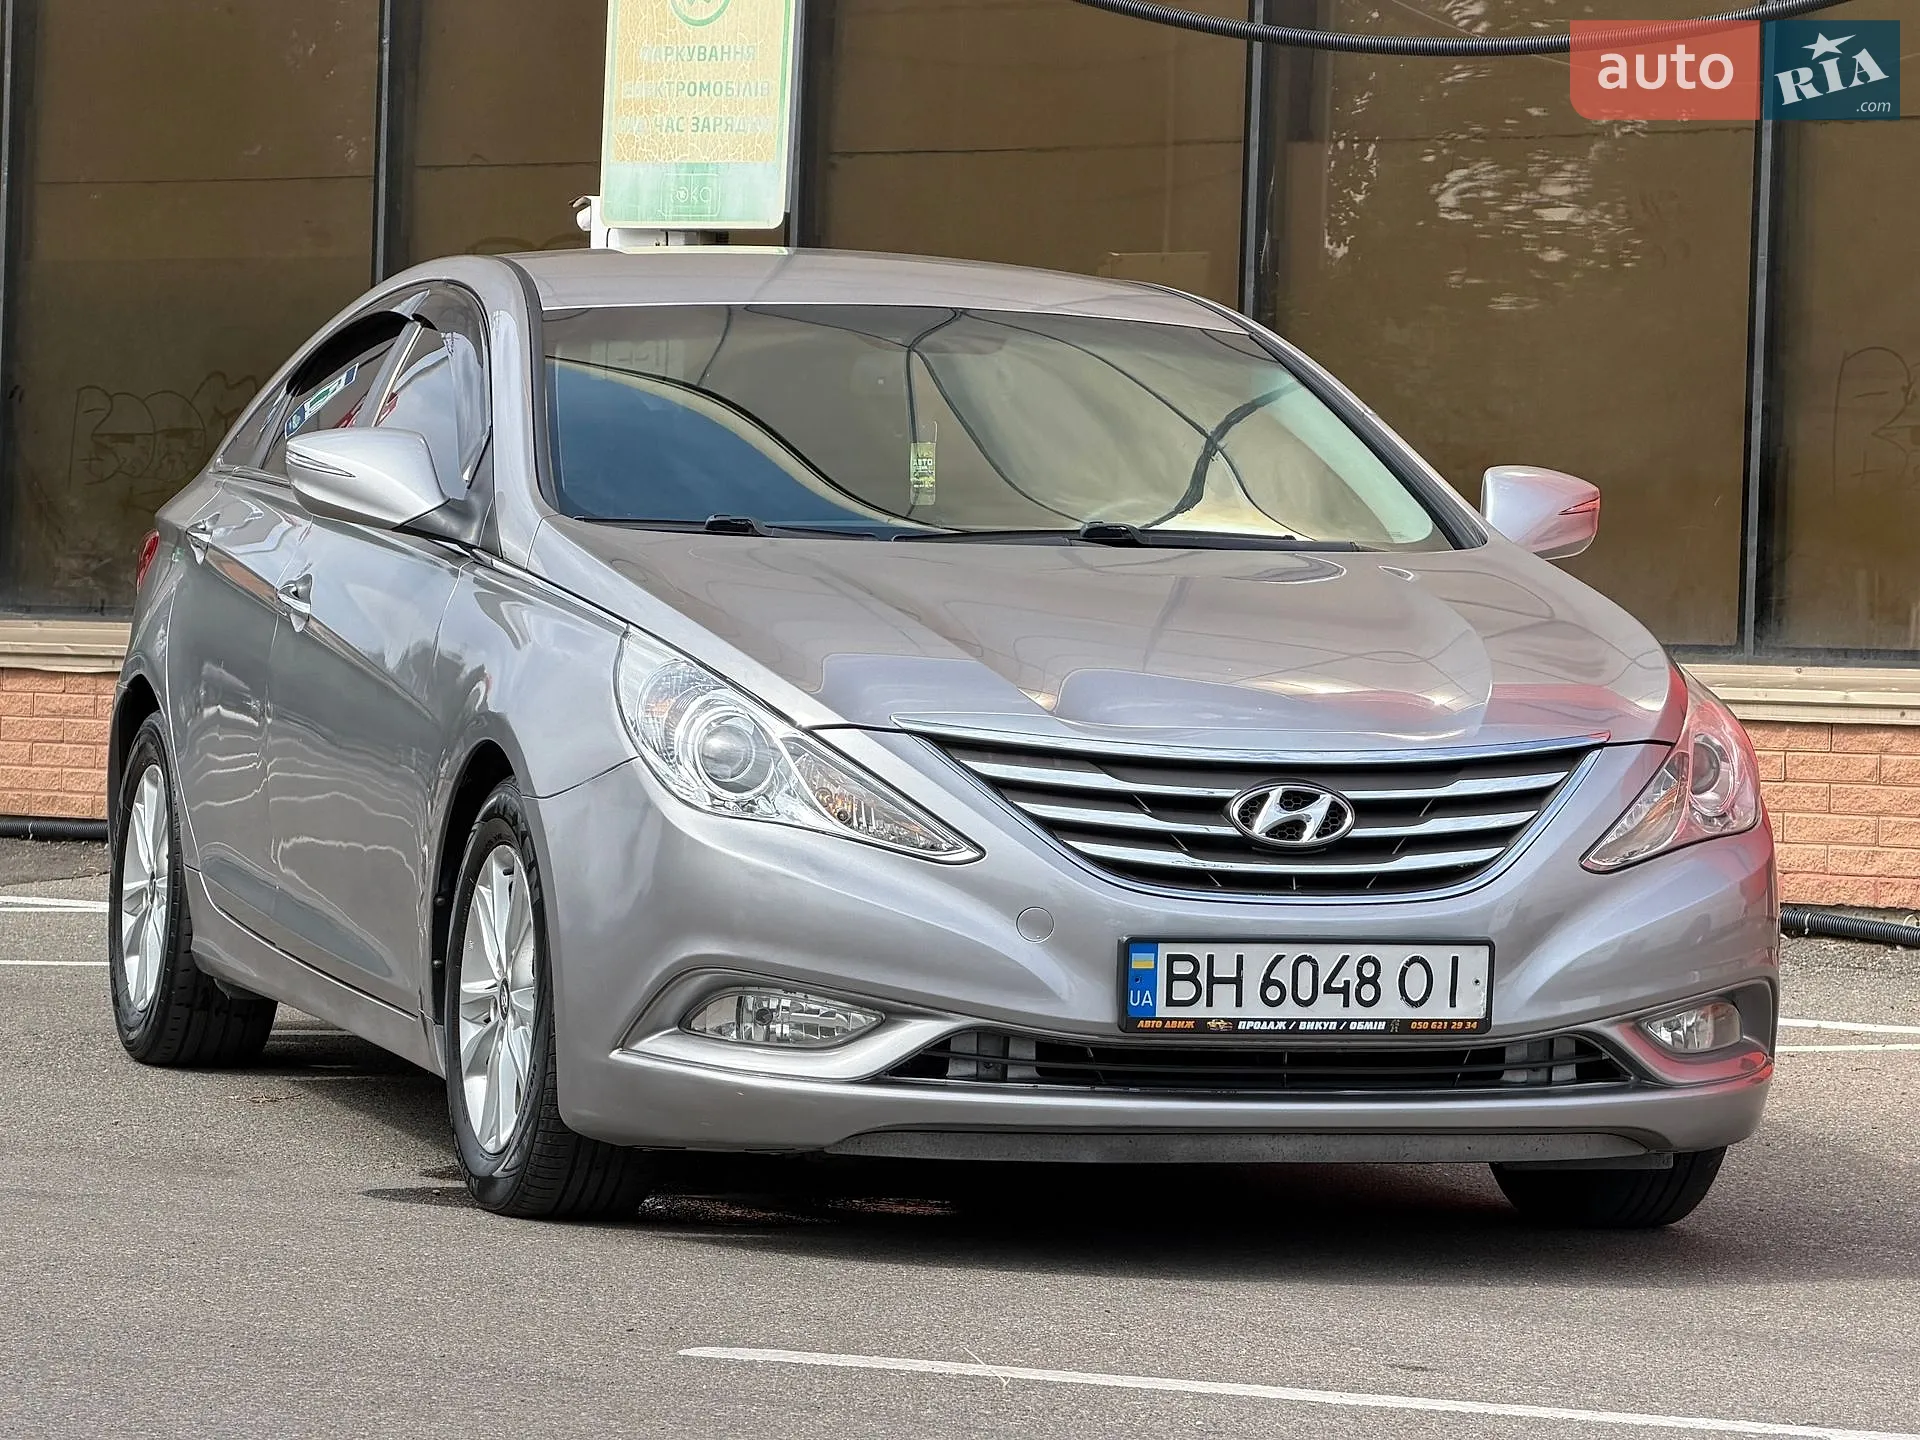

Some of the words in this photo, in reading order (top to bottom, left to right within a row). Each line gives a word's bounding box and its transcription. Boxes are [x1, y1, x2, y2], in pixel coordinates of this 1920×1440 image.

[622, 80, 771, 98] КТРОМОБІЛІВ
[654, 116, 685, 133] ЧАС
[691, 116, 772, 133] ЗАРЯД
[1166, 953, 1244, 1008] BH
[1259, 953, 1382, 1009] 6048
[1129, 990, 1154, 1007] UA
[1137, 1020, 1163, 1030] АВТО
[1237, 1020, 1287, 1030] ПРОДАЖ
[1298, 1020, 1338, 1030] ВИКУП
[1349, 1021, 1387, 1030] ОБМІН
[1410, 1021, 1430, 1030] 050
[1450, 1021, 1464, 1030] 29
[1464, 1021, 1479, 1030] 34
